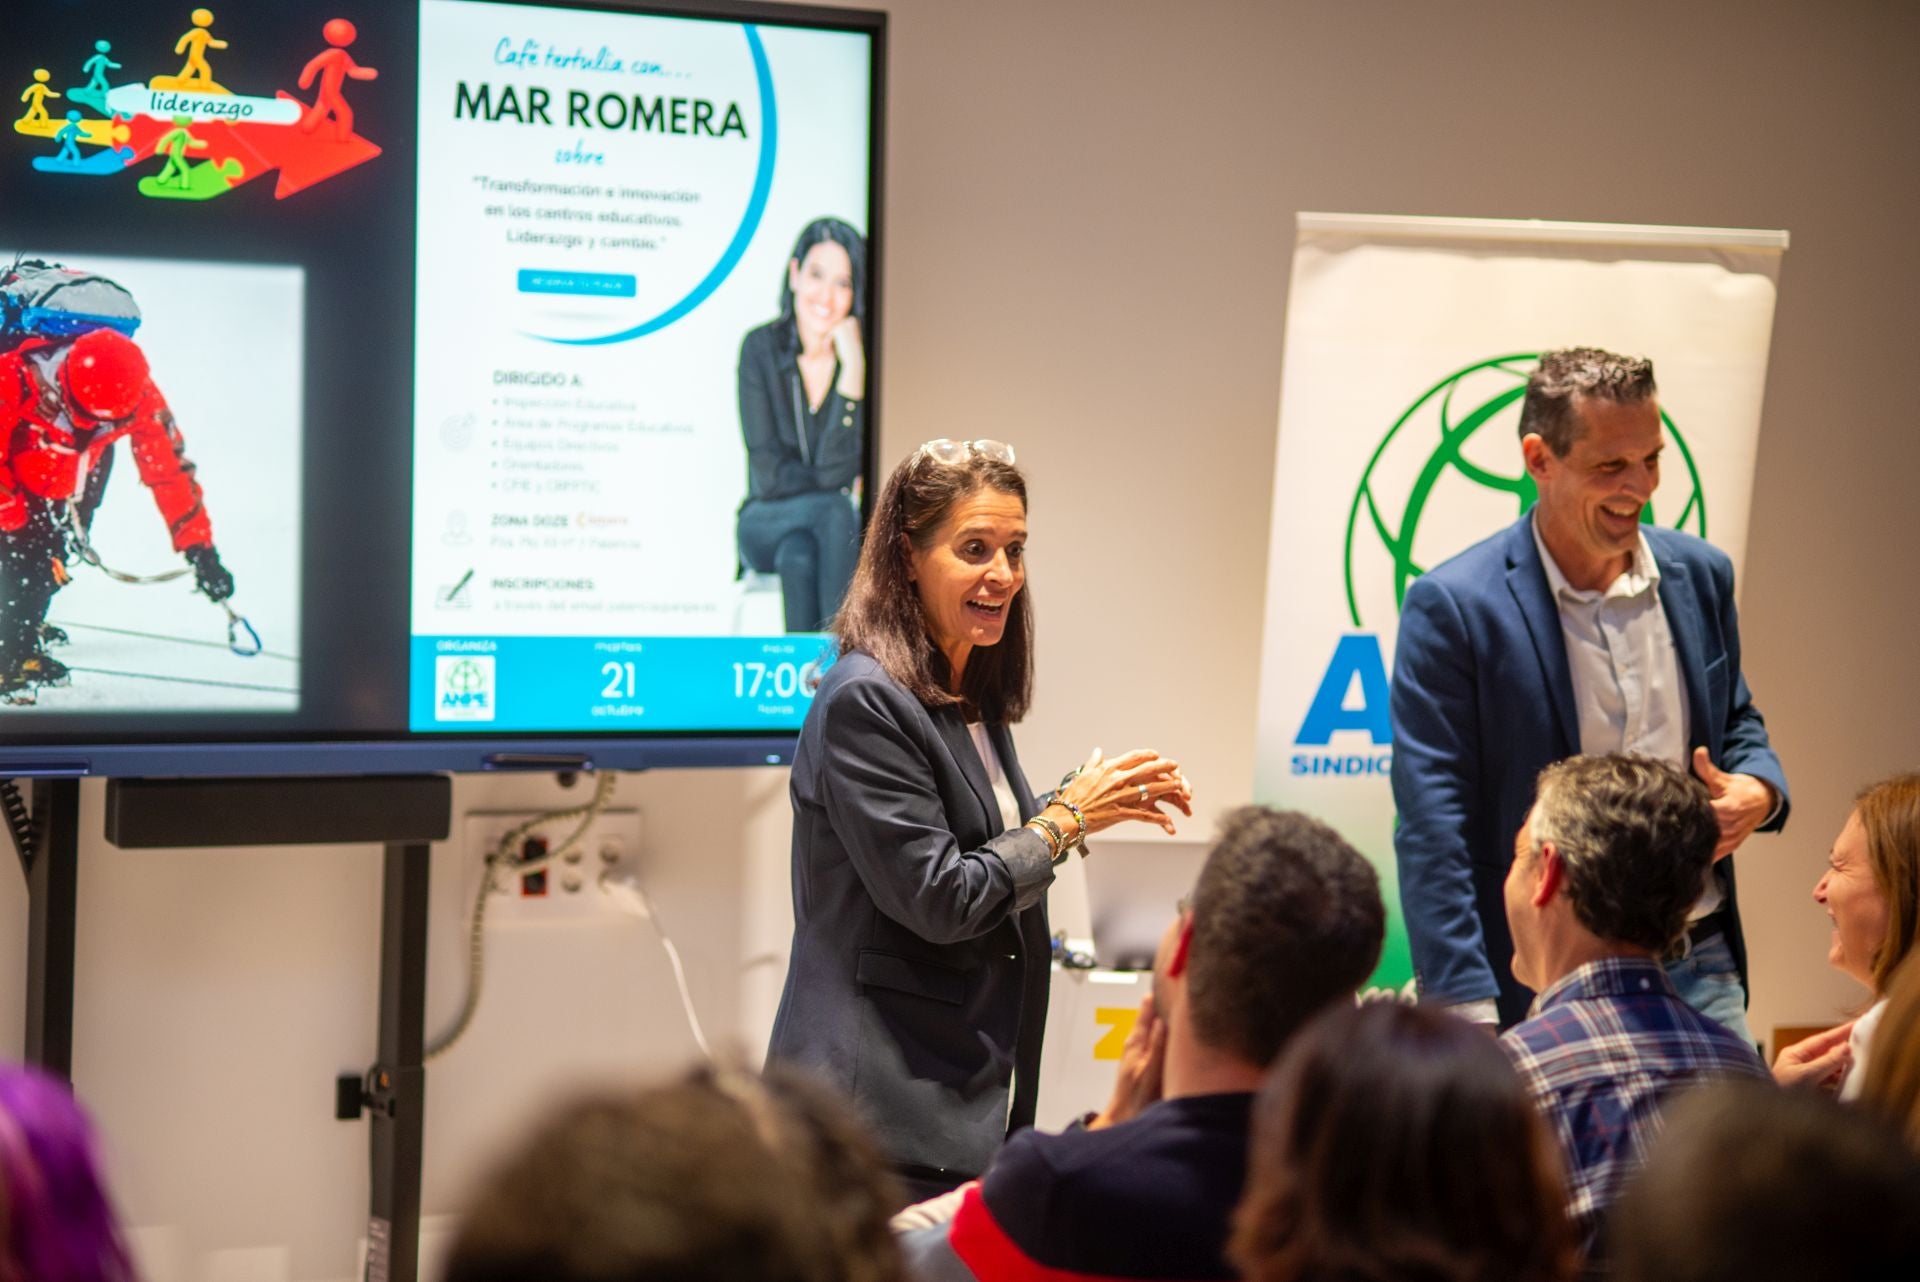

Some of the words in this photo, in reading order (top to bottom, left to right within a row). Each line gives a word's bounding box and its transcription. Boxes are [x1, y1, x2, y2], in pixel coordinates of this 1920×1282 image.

[544, 46, 624, 73] tertulia
[150, 91, 253, 121] liderazgo
[454, 81, 551, 125] MAR
[567, 90, 748, 139] ROMERA
[555, 139, 605, 165] sobre
[484, 204, 503, 218] en
[507, 203, 531, 219] los
[535, 207, 593, 222] centros
[506, 229, 583, 251] Liderazgo
[492, 370, 566, 386] DIRIGIDO
[601, 661, 636, 699] 21
